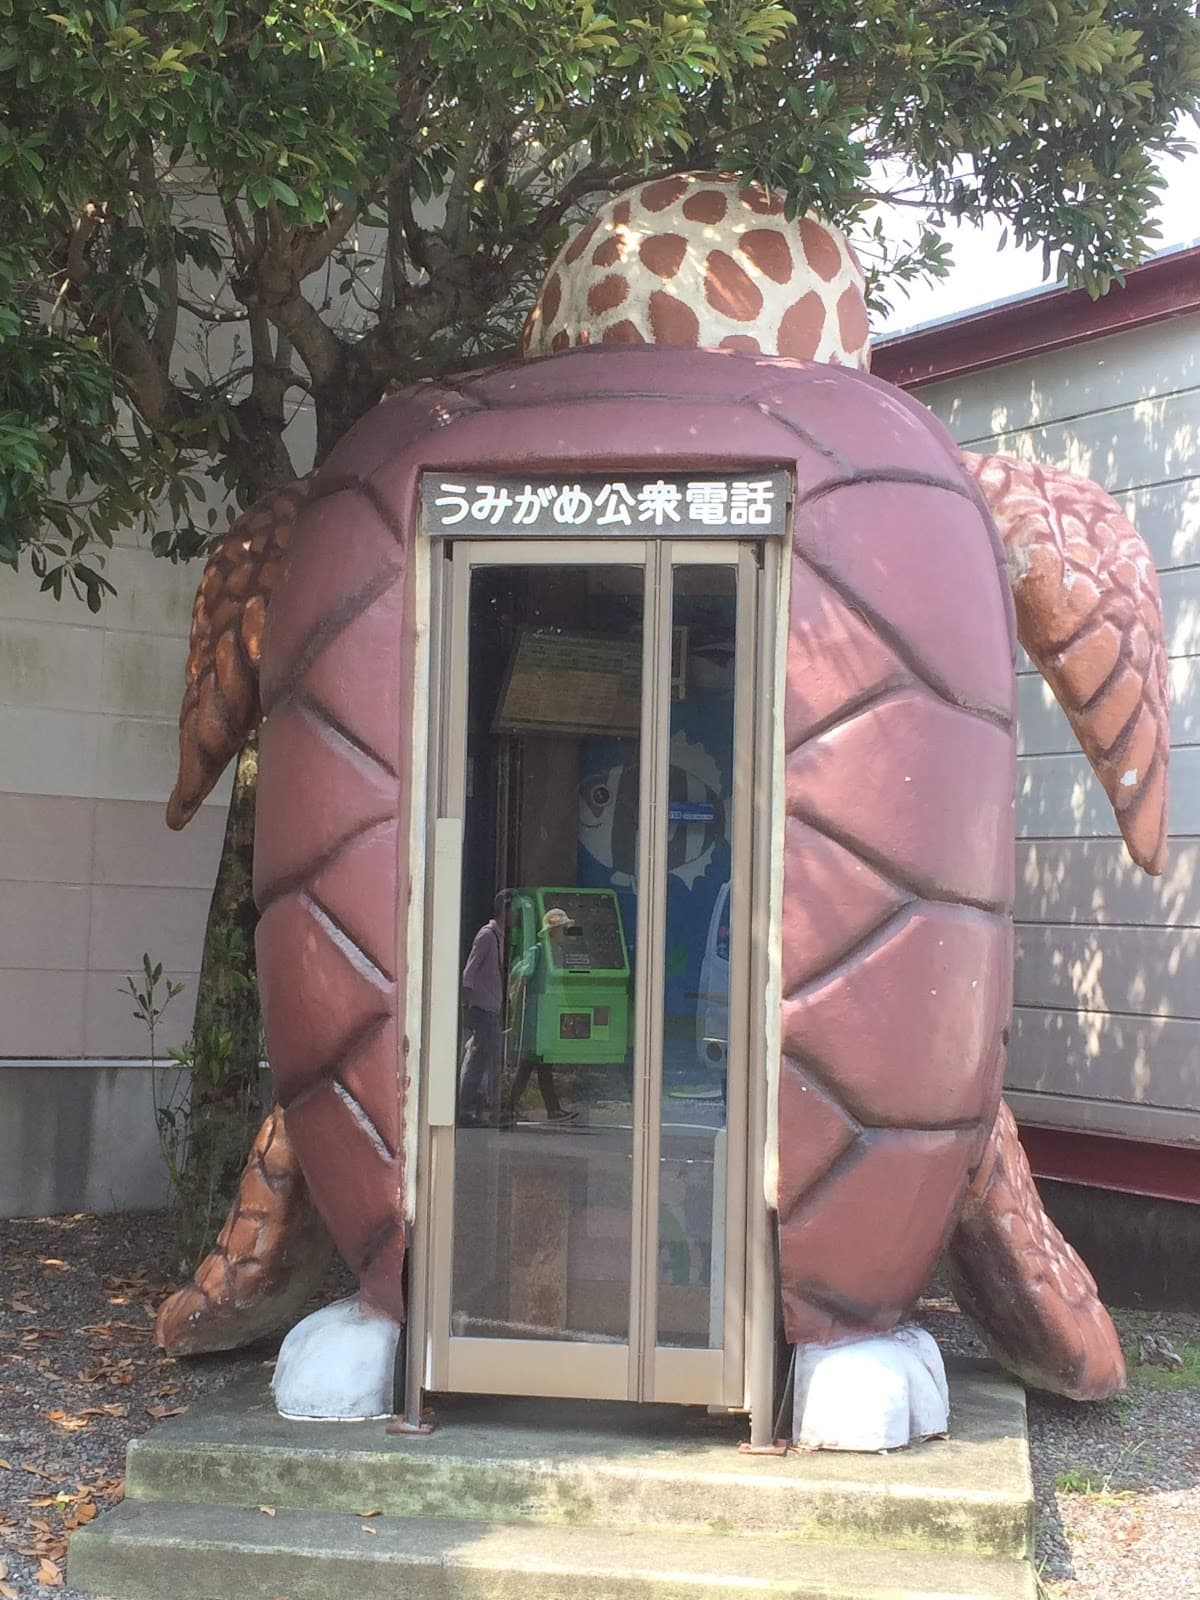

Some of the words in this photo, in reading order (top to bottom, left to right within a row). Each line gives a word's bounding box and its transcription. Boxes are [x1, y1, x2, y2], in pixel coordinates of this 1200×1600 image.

[434, 480, 775, 526] うみがめ公衆電話
